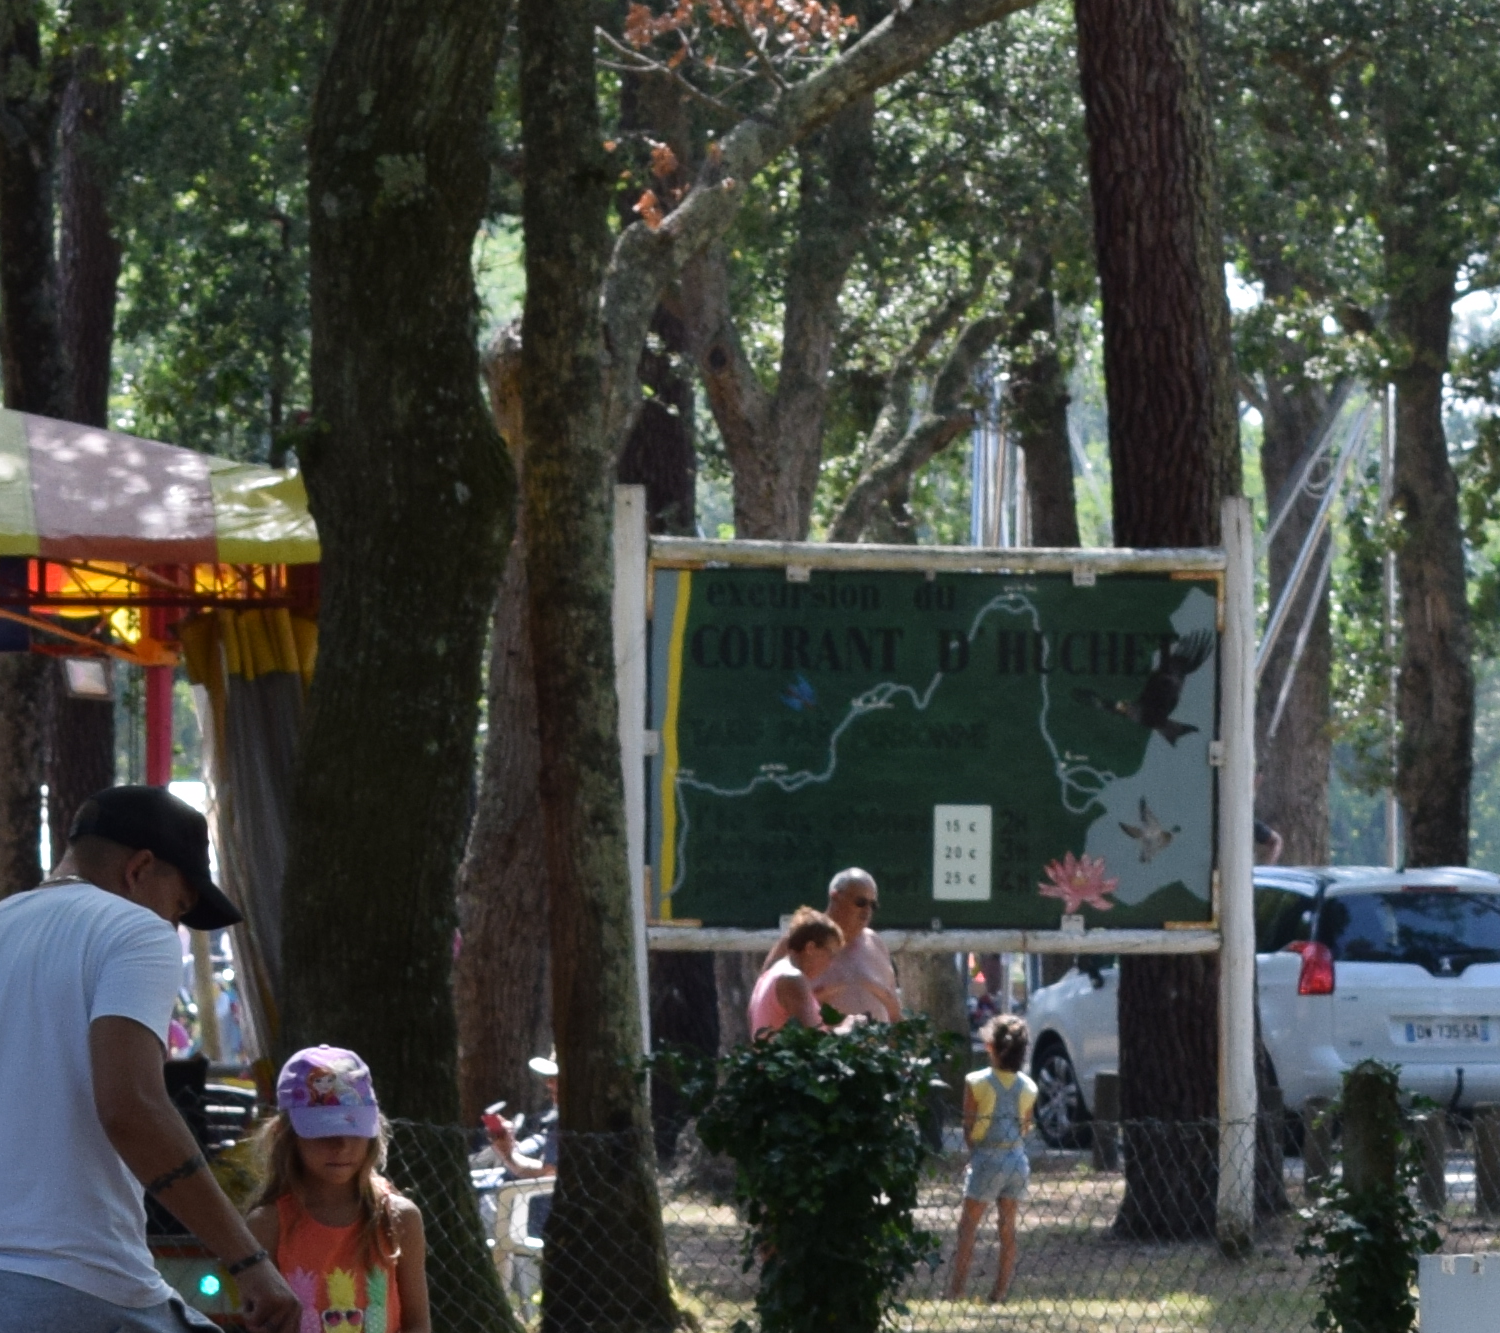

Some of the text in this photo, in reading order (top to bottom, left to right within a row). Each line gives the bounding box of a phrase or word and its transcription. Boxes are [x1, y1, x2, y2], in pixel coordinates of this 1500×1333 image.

[706, 577, 956, 612] excursion du
[690, 624, 904, 672] COURANT
[945, 819, 960, 832] 15
[945, 845, 962, 859] 20
[944, 871, 961, 885] 25
